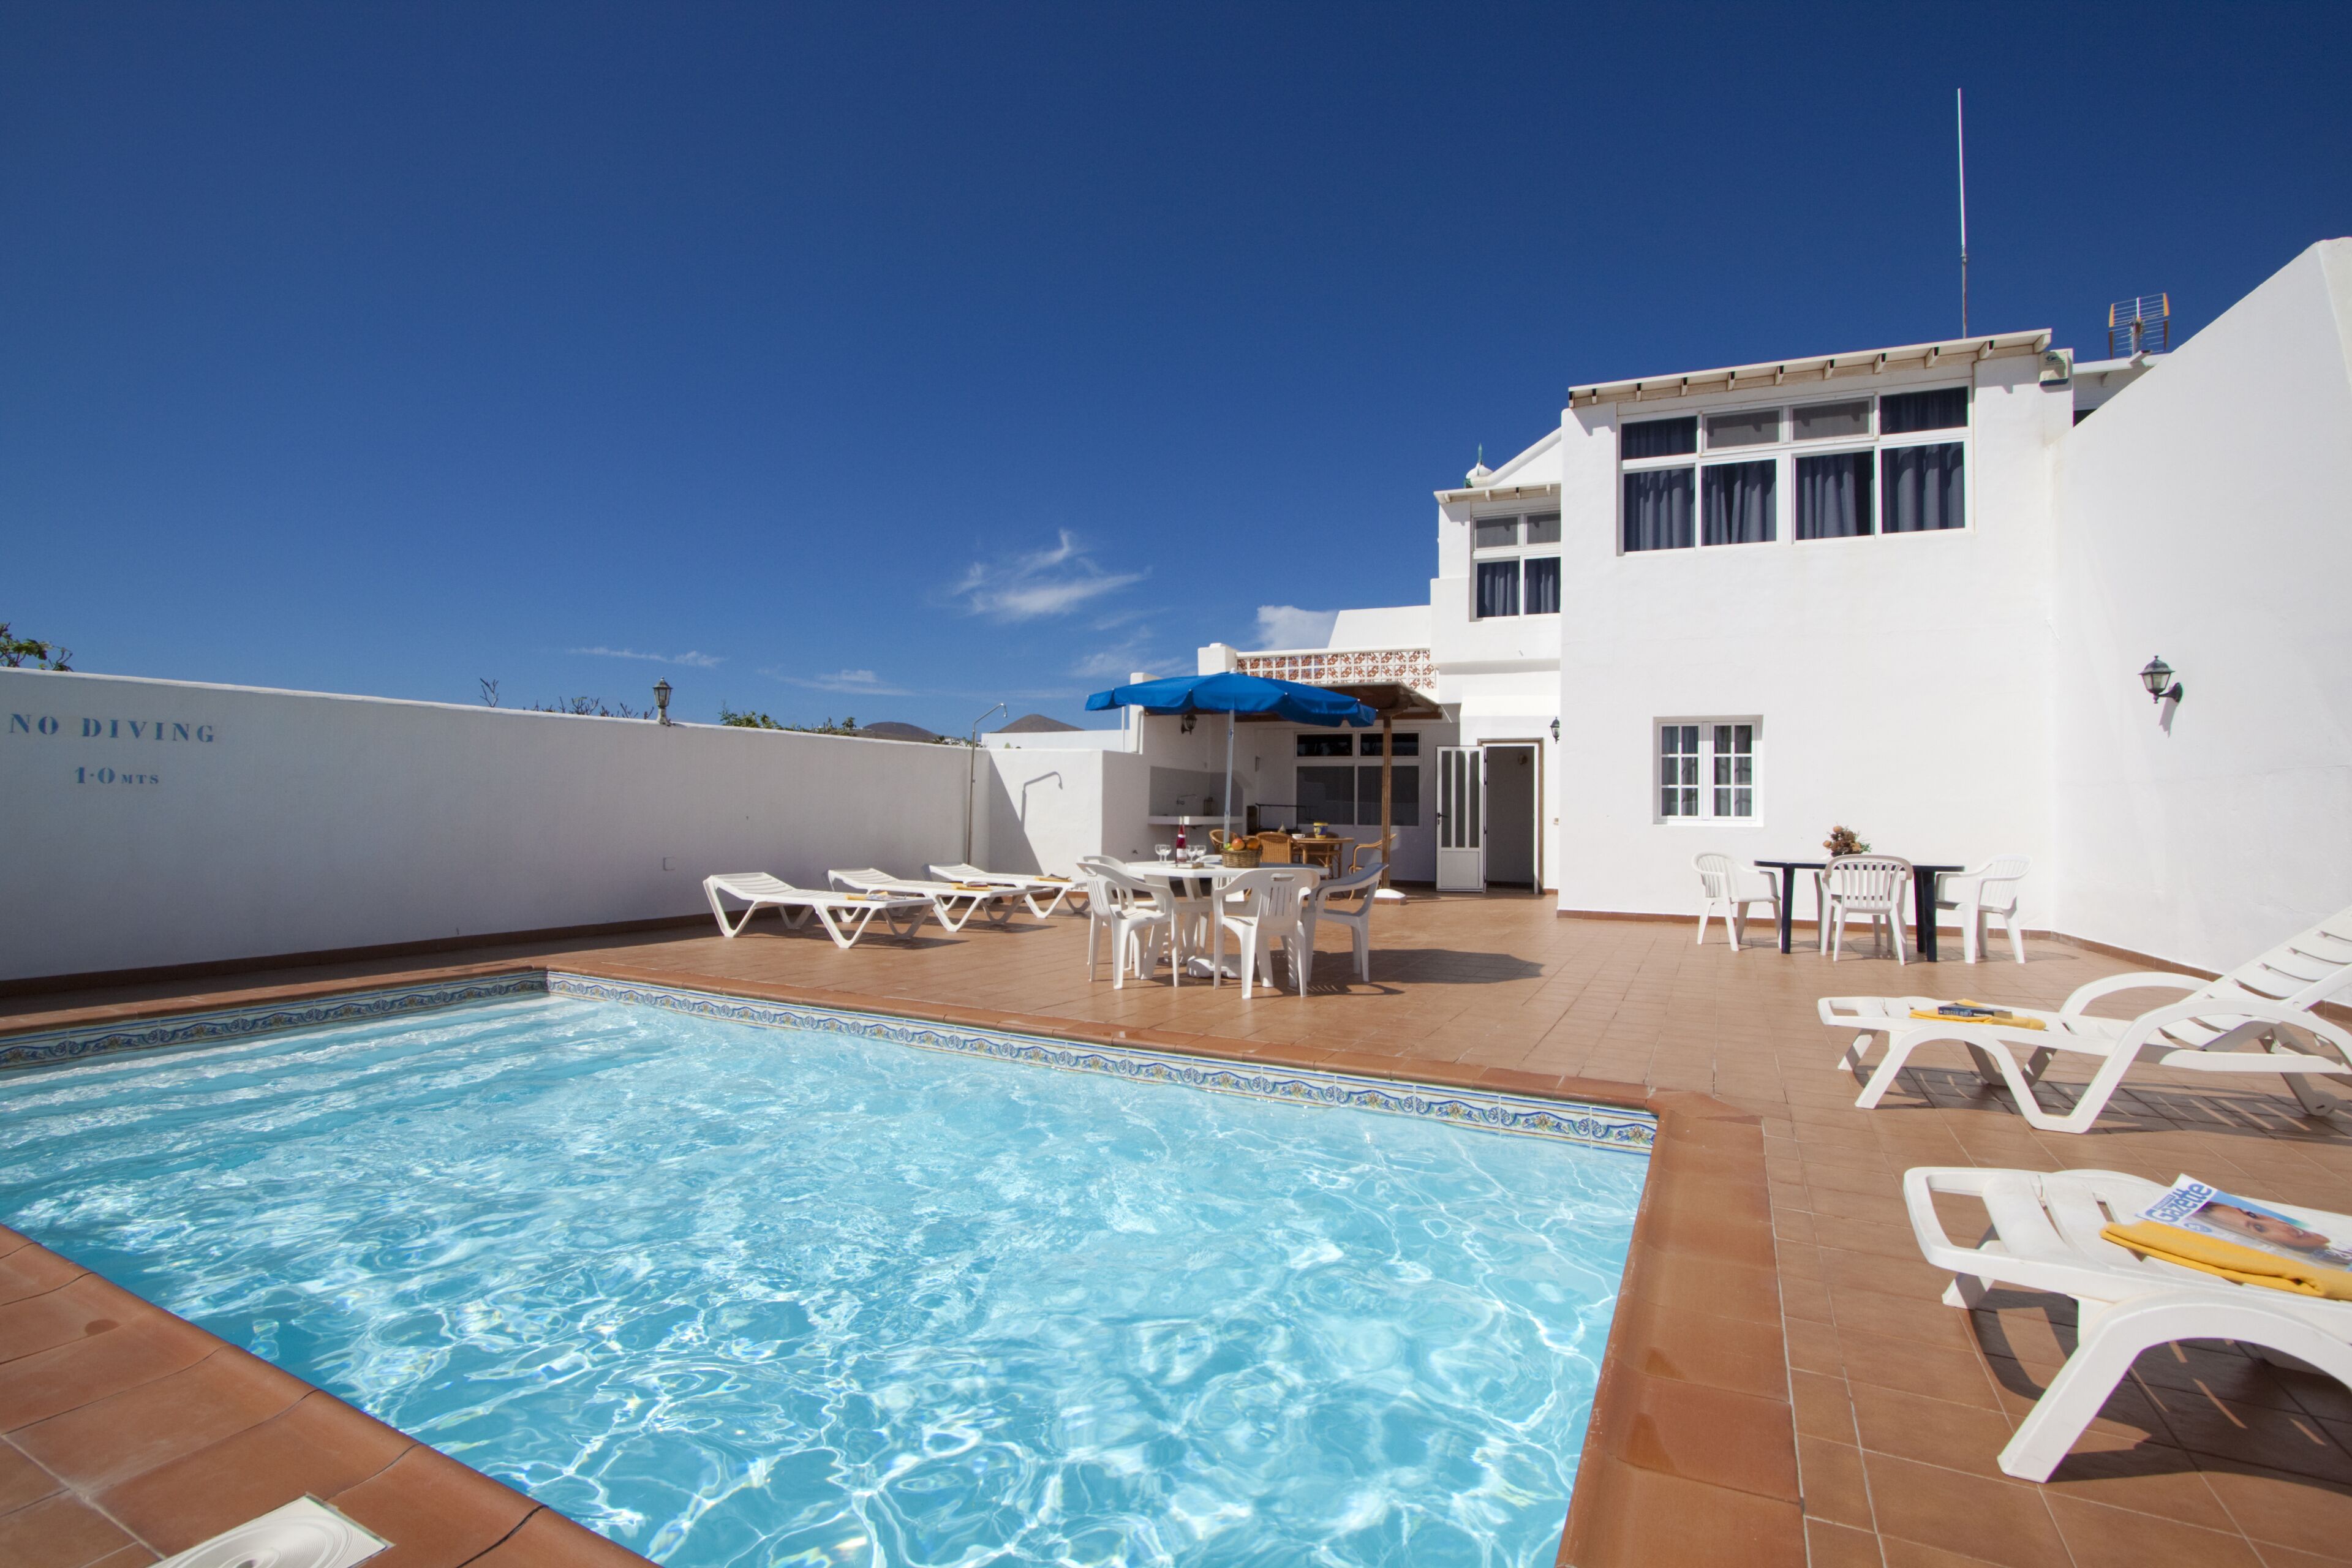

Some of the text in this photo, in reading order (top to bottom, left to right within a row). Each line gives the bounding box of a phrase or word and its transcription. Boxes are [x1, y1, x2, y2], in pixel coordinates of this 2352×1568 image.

[9, 714, 214, 742] NO DIVING
[121, 774, 159, 785] MTS
[2145, 1183, 2212, 1223] Gazette
